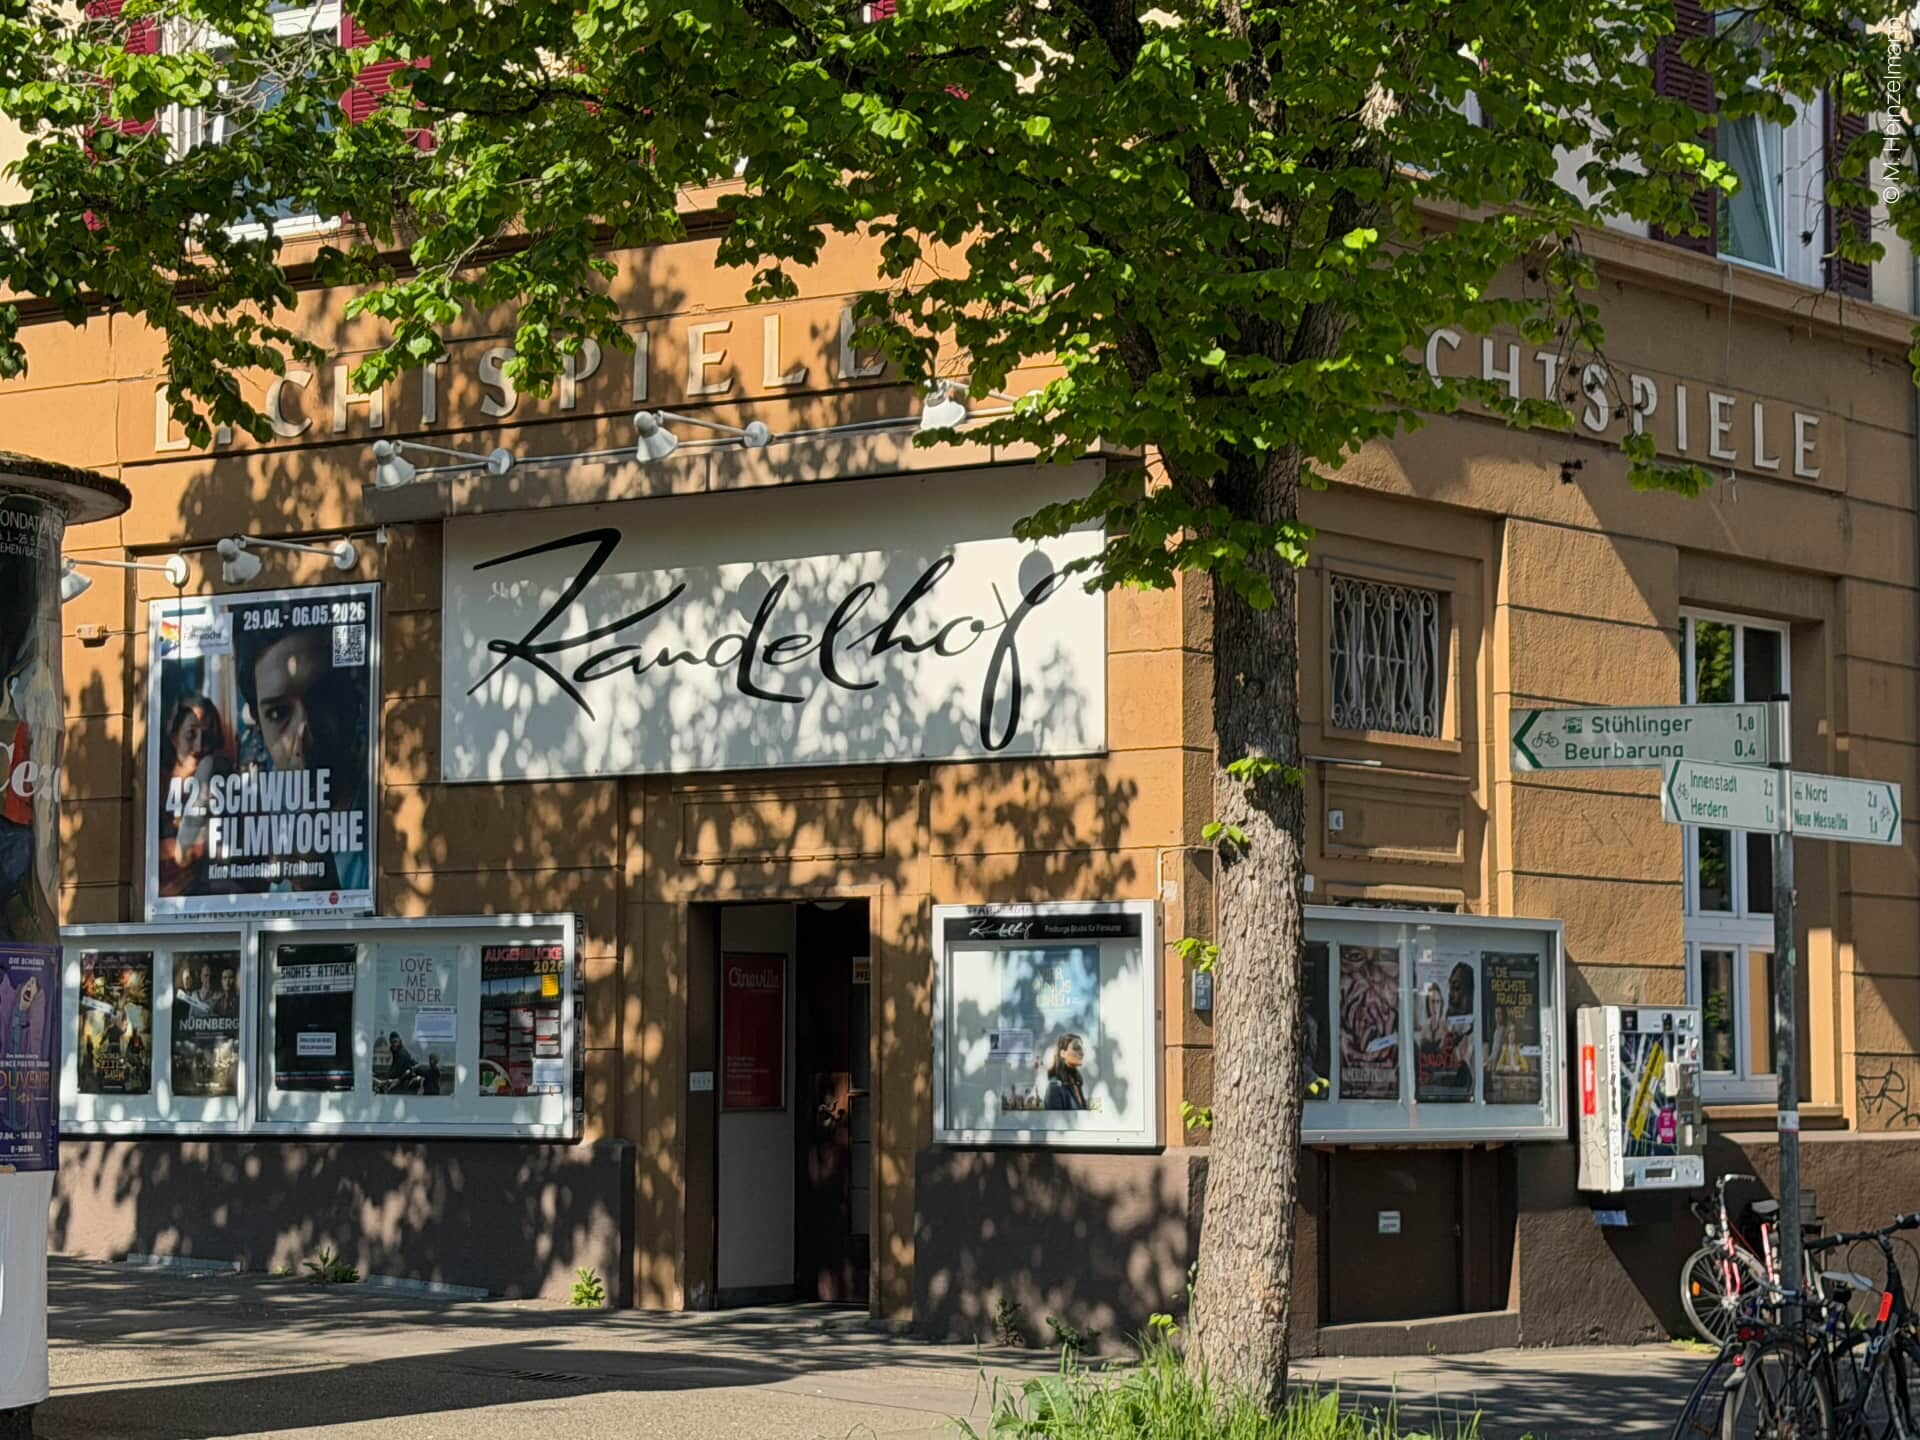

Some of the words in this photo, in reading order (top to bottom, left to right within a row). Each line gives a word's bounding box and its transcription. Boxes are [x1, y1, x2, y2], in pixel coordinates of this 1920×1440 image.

[155, 306, 886, 453] LCHTSPIELE
[292, 602, 366, 627] 06.05.2026
[466, 527, 1072, 752] Kandelhof
[1591, 716, 1693, 736] Stühlinger
[1565, 742, 1684, 760] Beurbarung
[1690, 769, 1737, 793] Innenstadt
[166, 776, 206, 817] 42.
[209, 768, 331, 816] SCHWULE
[1805, 783, 1828, 803] Nord
[1690, 798, 1729, 819] Herdern
[209, 811, 364, 859] FILMWOCHE
[208, 864, 227, 880] Kino
[230, 862, 280, 879] Kandelhof
[283, 861, 325, 878] Freiburg
[281, 966, 312, 979] SHORTS
[400, 957, 433, 973] LOVE
[533, 960, 565, 974] 2026
[406, 974, 427, 989] ME
[390, 988, 441, 1003] TENDER
[179, 1015, 240, 1031] NÜRNBERG
